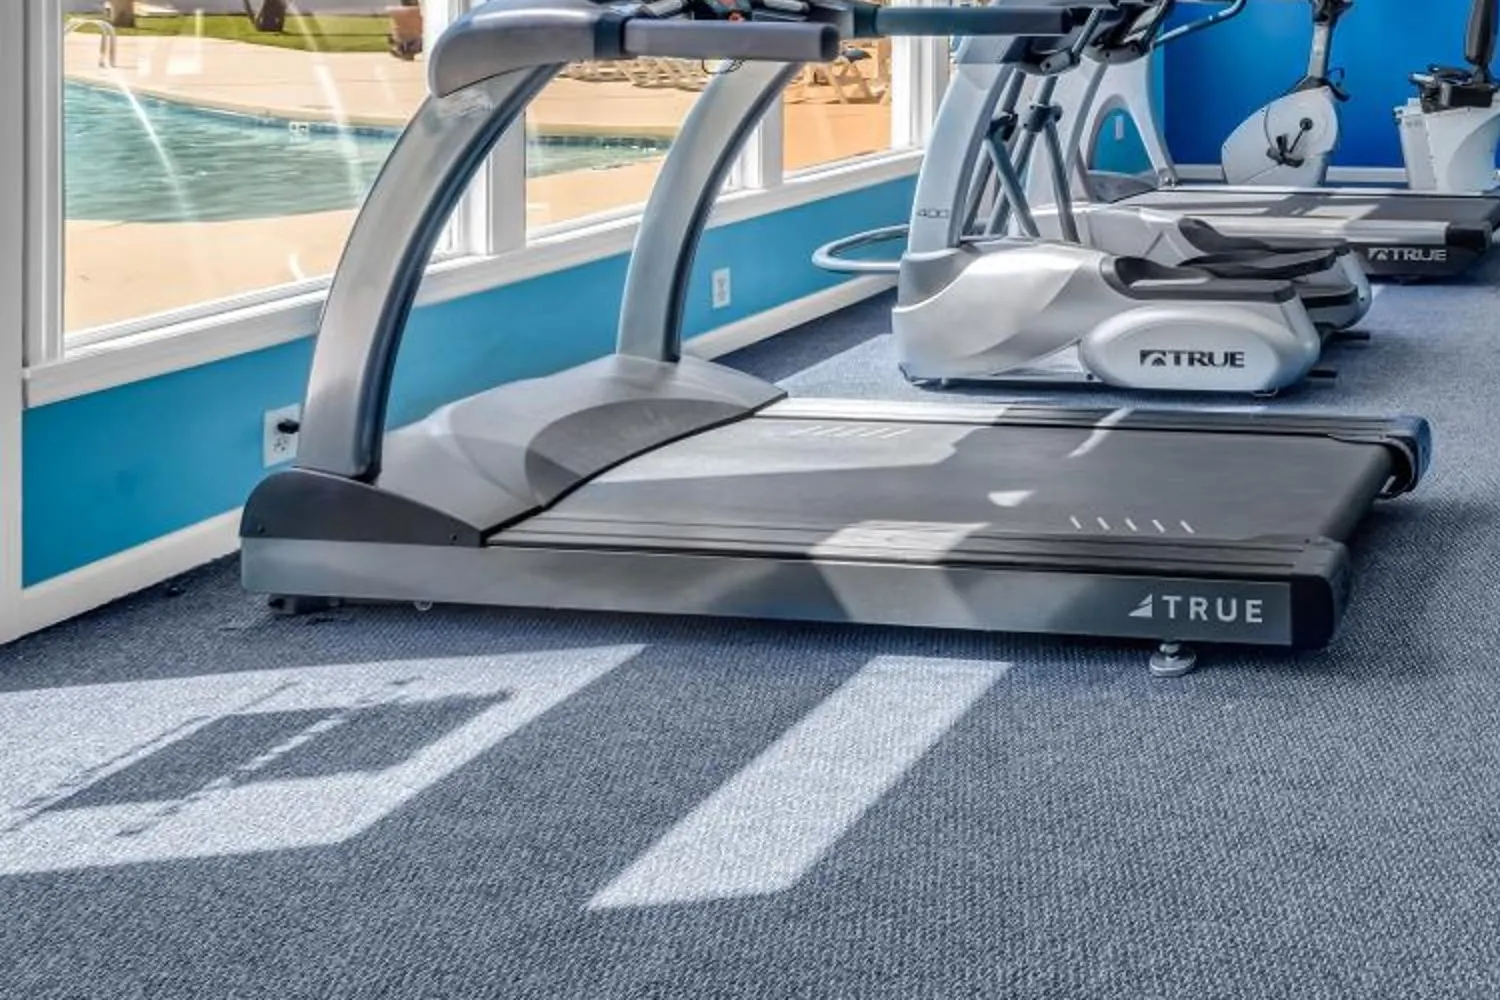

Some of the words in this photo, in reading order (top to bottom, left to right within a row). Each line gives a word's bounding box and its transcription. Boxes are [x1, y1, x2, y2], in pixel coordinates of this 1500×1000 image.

[1388, 247, 1447, 261] TRUE
[1167, 350, 1245, 369] TRUE
[1161, 595, 1263, 623] TRUE
